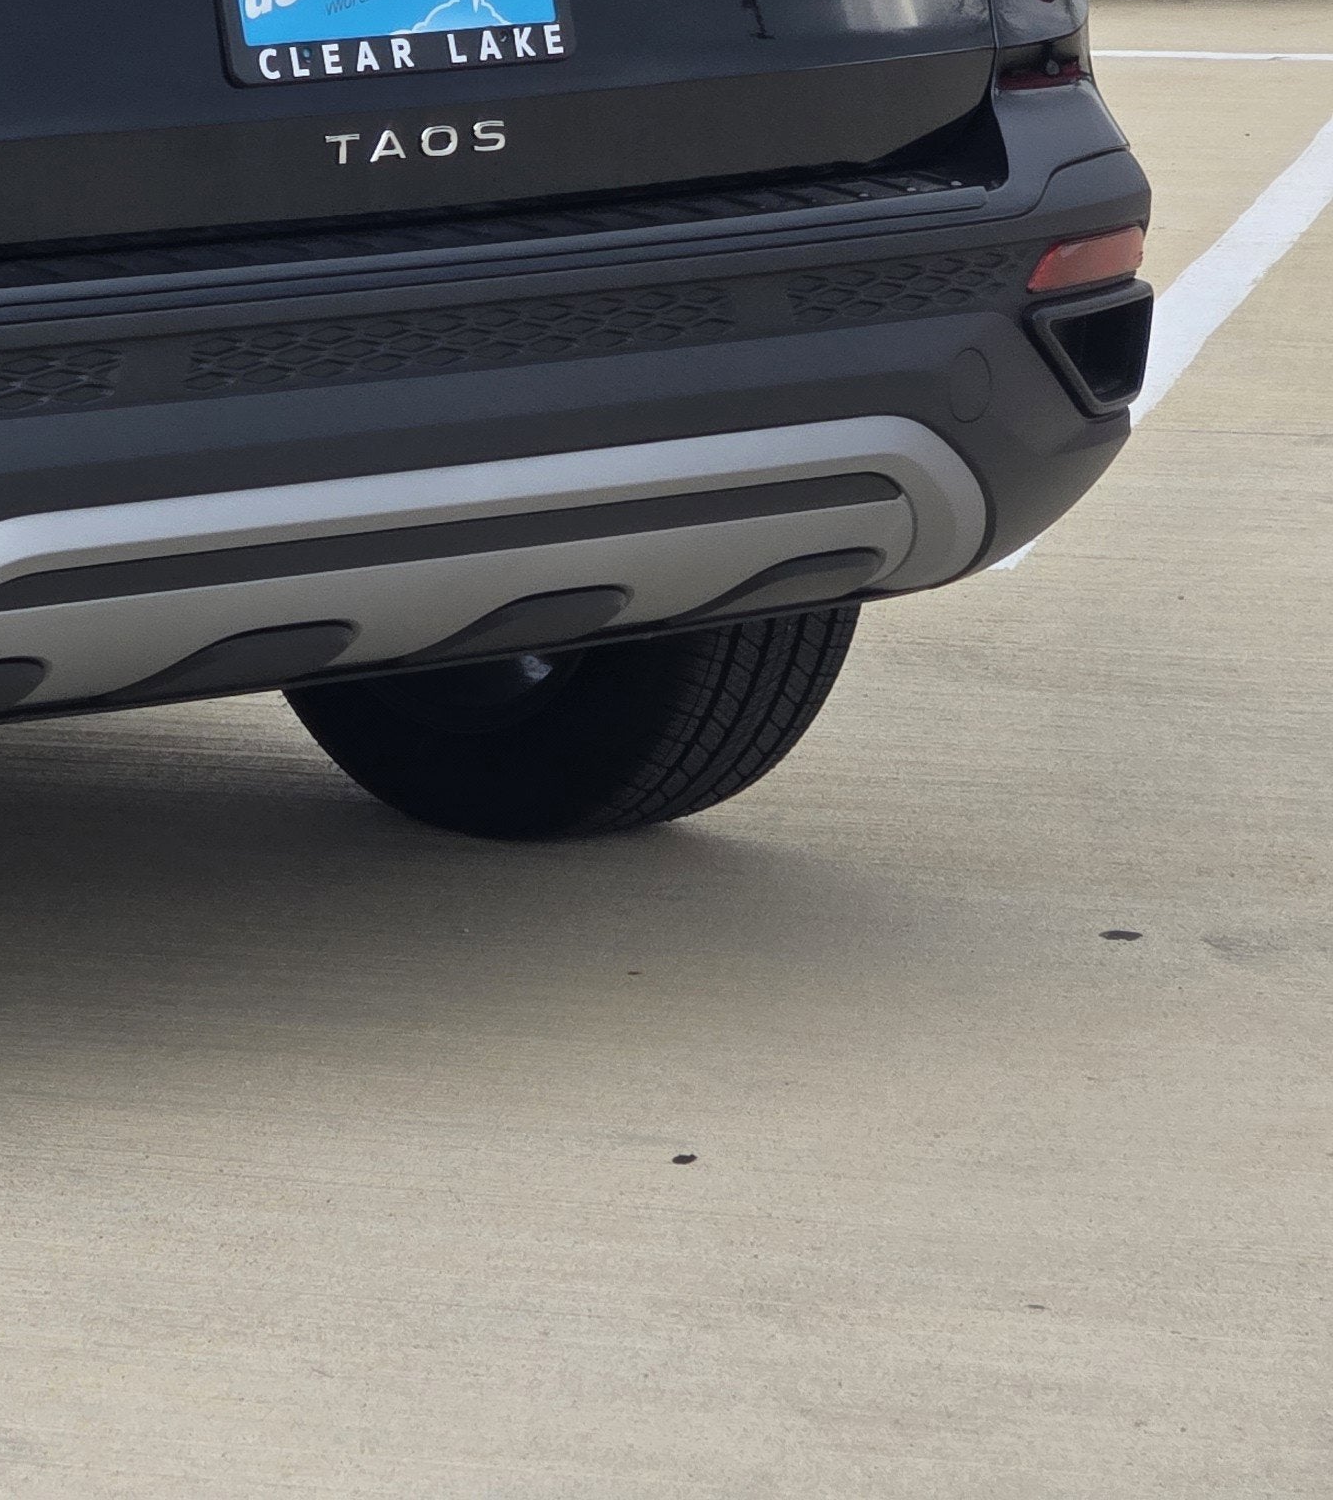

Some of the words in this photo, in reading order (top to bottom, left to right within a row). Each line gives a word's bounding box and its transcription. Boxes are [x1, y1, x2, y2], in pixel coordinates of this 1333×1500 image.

[258, 40, 415, 81] CLEAR
[447, 24, 565, 64] LAKE
[324, 119, 508, 165] TAOS
